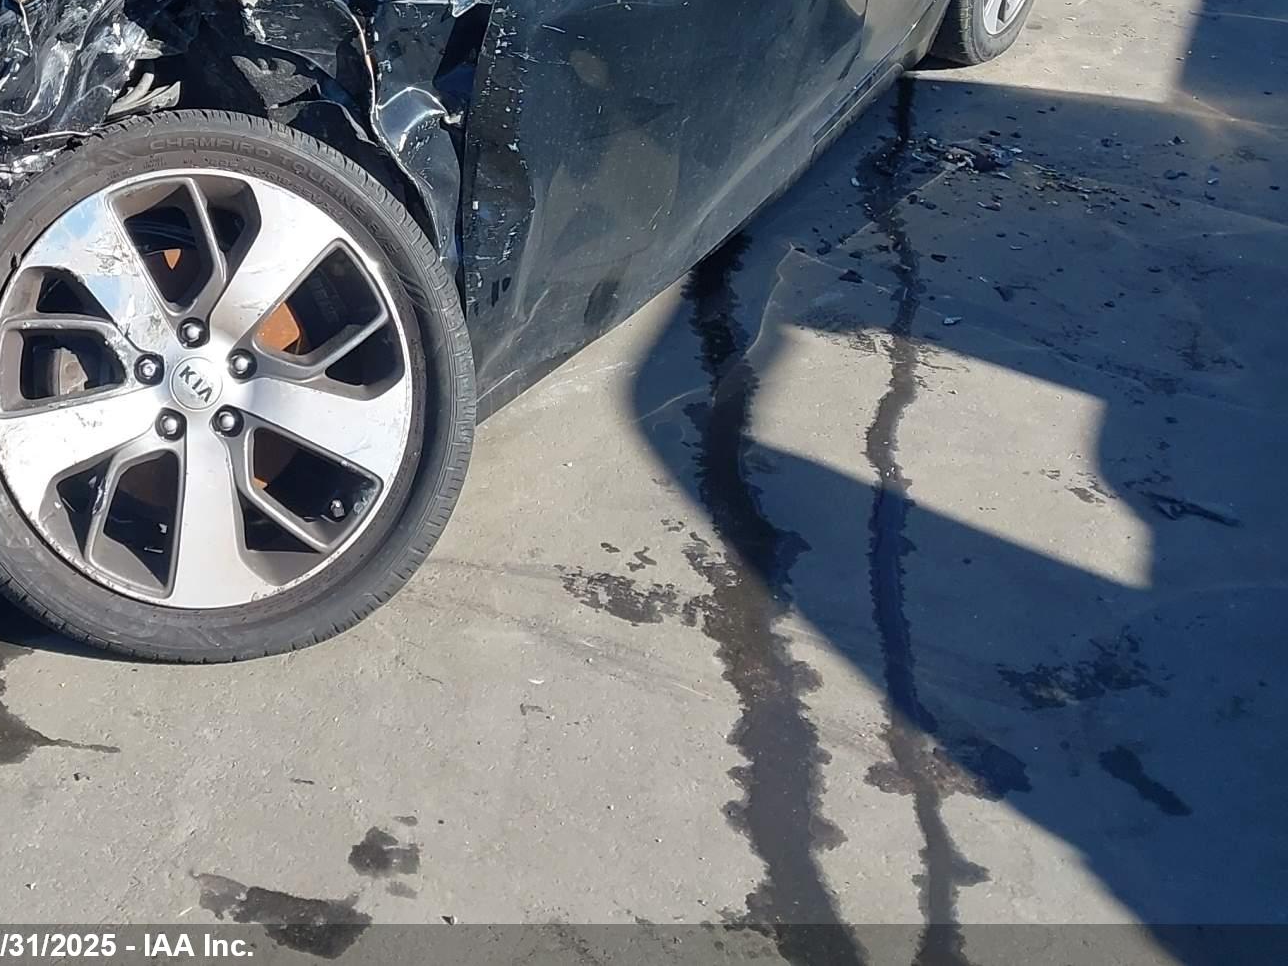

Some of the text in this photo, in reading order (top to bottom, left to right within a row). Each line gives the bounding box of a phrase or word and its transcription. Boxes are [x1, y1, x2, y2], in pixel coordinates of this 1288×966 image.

[150, 136, 271, 158] CHAMPIRO
[280, 154, 367, 218] TOURING
[179, 365, 213, 403] KIA
